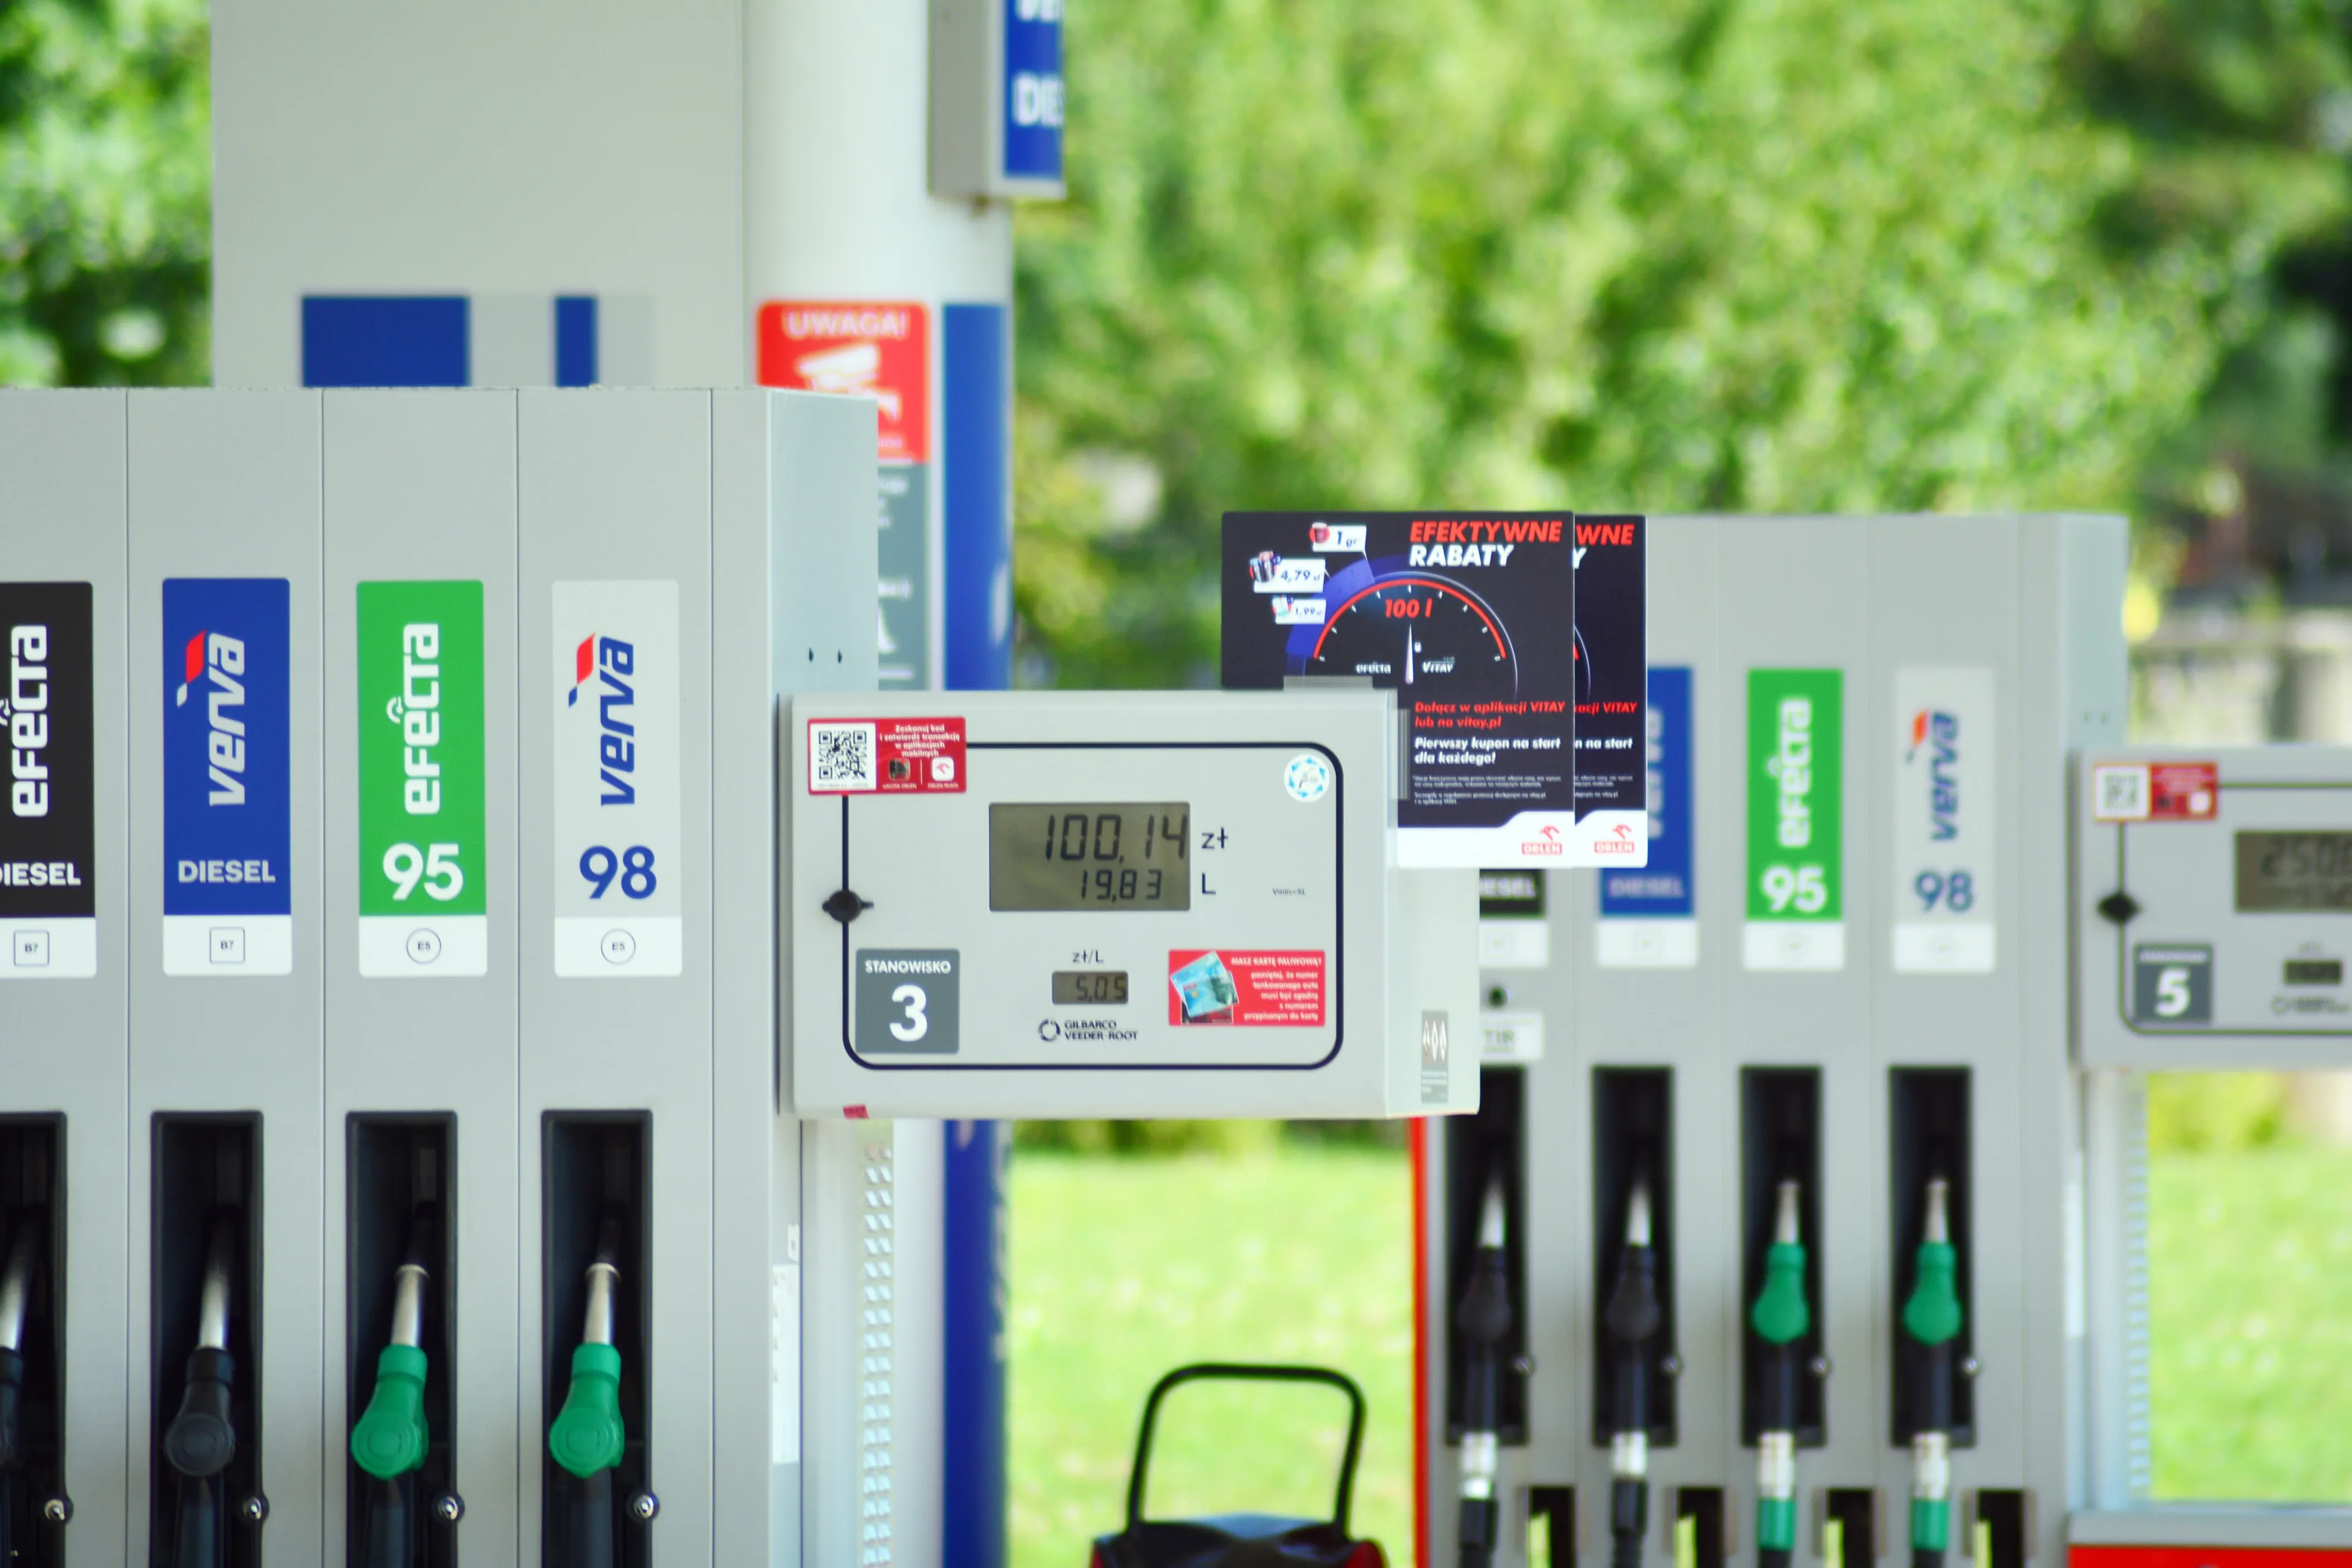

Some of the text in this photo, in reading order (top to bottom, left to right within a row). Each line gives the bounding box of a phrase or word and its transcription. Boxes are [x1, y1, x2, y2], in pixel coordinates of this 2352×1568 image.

[786, 311, 907, 337] UWAGA!
[1410, 521, 1563, 543] EFEKTYWNE
[1409, 544, 1515, 567] RABATY
[1385, 598, 1420, 618] 100
[1415, 701, 1457, 715] Dołącz
[1460, 704, 1471, 713] w
[1473, 701, 1528, 716] aplikacji
[1530, 701, 1566, 714] VITAY
[1603, 702, 1638, 714] VITAY
[209, 632, 246, 807] verva
[600, 635, 635, 807] verva
[930, 724, 945, 733] kod
[1415, 716, 1502, 730] lub na vitay.pl
[903, 741, 945, 751] aplikacjach
[1414, 737, 1469, 752] Pierwszy
[1471, 736, 1510, 752] kupon
[1512, 739, 1529, 749] na
[1532, 737, 1562, 749] start
[1585, 739, 1602, 749] na
[1605, 737, 1634, 749] start
[901, 750, 939, 759] mobilnych
[1414, 751, 1496, 766] dla każdego!
[1929, 710, 1960, 843] verva
[1201, 827, 1229, 849] zł
[1596, 842, 1634, 853] ORLEN
[1523, 843, 1561, 854] ORLEN
[0, 862, 81, 886] IESEL
[178, 861, 276, 883] DIESEL
[383, 843, 464, 901] 95
[579, 845, 657, 900] 98
[1081, 869, 1163, 903] 19,83
[1201, 873, 1216, 894] L
[1609, 877, 1684, 898] DIESEL
[1760, 865, 1828, 913] 95
[1914, 871, 1974, 913] 98
[24, 943, 38, 954] B7
[221, 940, 234, 951] B7
[417, 941, 431, 951] E5
[612, 941, 625, 951] E5
[865, 960, 951, 974] STANOWISKO
[1231, 957, 1252, 966] MASZ
[1254, 957, 1276, 967] KARTĘ
[1076, 975, 1126, 1003] 5,05
[2155, 968, 2192, 1016] 5
[890, 985, 928, 1042] 3
[1064, 1020, 1117, 1030] GILBARCO
